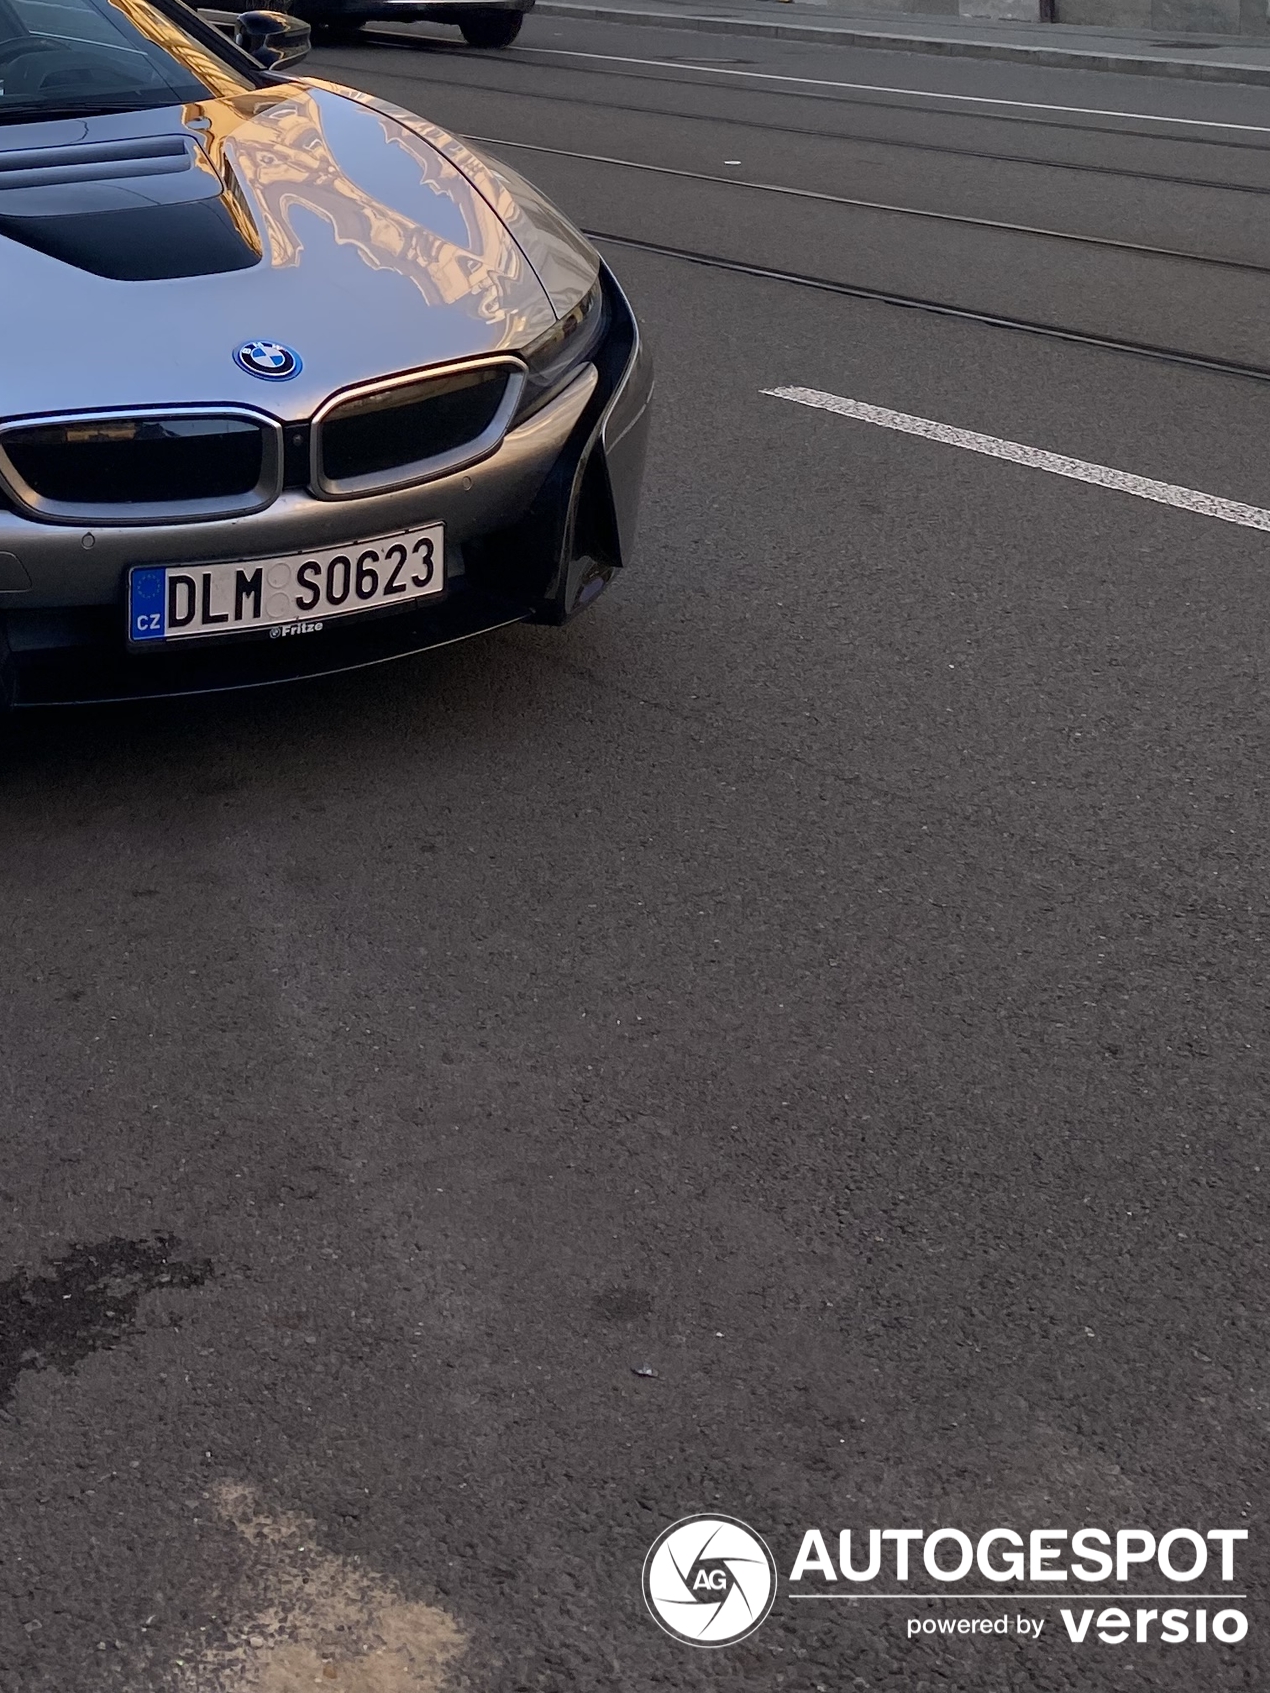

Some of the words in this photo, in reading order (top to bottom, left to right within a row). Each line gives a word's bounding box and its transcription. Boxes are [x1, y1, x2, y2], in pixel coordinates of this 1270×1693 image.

[168, 567, 263, 628] DLM
[295, 537, 435, 611] S0623
[137, 613, 161, 631] CZ
[280, 621, 323, 637] Fritze
